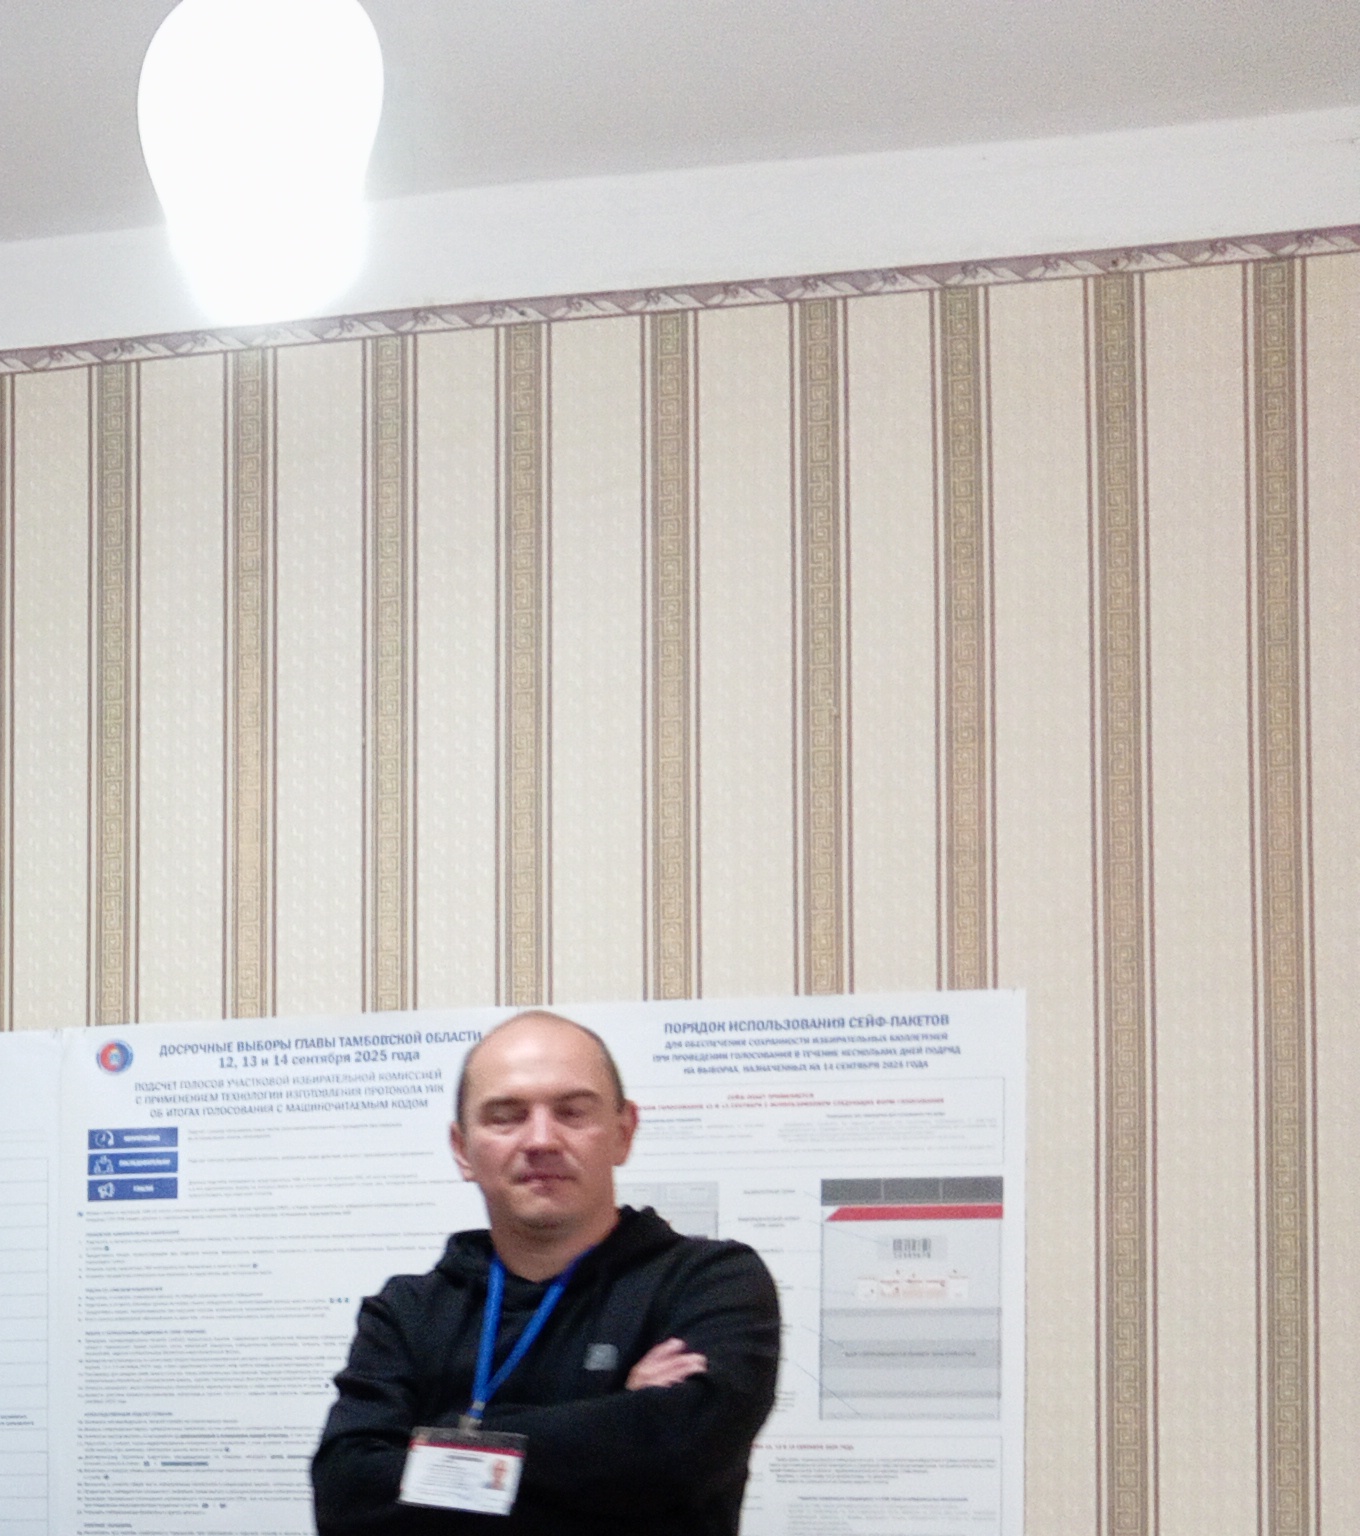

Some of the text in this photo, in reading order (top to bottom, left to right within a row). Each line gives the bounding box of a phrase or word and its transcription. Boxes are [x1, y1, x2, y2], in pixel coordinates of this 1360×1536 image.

[664, 1014, 949, 1035] ПОРЯДОК ИСПОЛЬЗОВАНИЯ СЕЙФ-ПАКЕТОВ
[159, 1041, 234, 1057] ДОСРОЧНЫЕ
[237, 1039, 291, 1053] ВЫБОРЫ
[295, 1037, 336, 1050] ГЛАВЫ
[340, 1031, 422, 1048] ТАМБОВСКОЙ
[219, 1050, 420, 1069] 12, 13 и 14 сентября 2025 года
